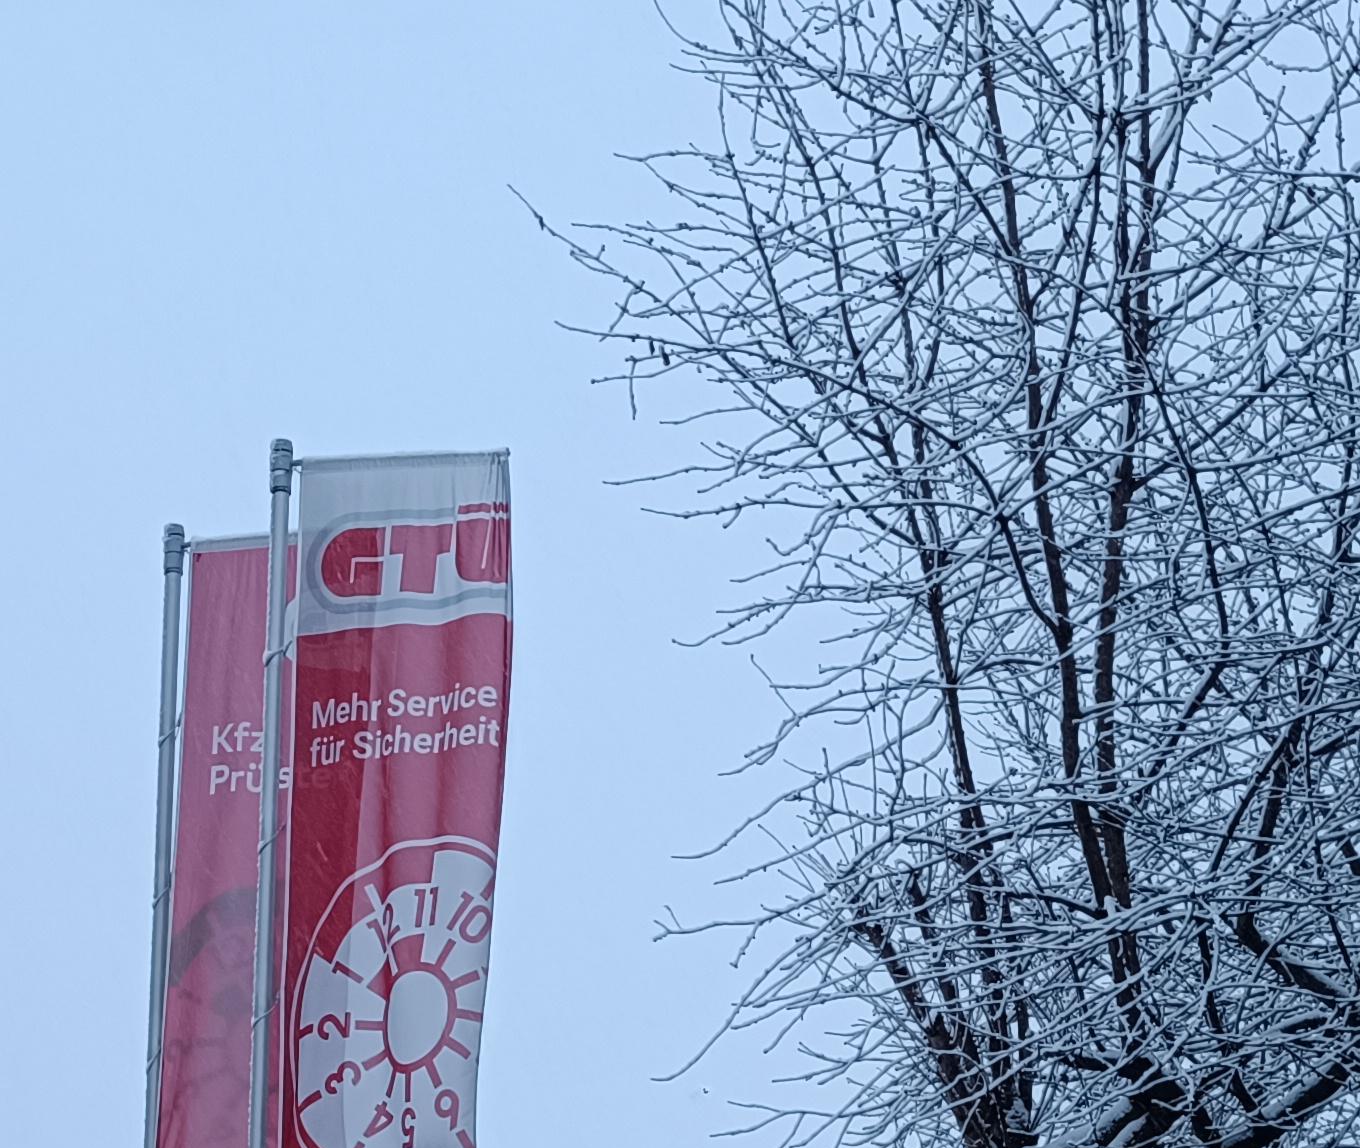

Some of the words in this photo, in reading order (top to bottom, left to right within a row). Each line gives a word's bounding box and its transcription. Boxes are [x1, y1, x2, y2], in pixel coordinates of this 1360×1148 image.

[320, 503, 508, 597] GTÜ
[312, 692, 381, 729] Mehr
[387, 683, 497, 717] Service
[310, 735, 345, 768] für
[352, 715, 500, 760] Sicherheit
[317, 1012, 351, 1040] 2
[325, 1061, 361, 1095] 3
[364, 1101, 393, 1139] 4
